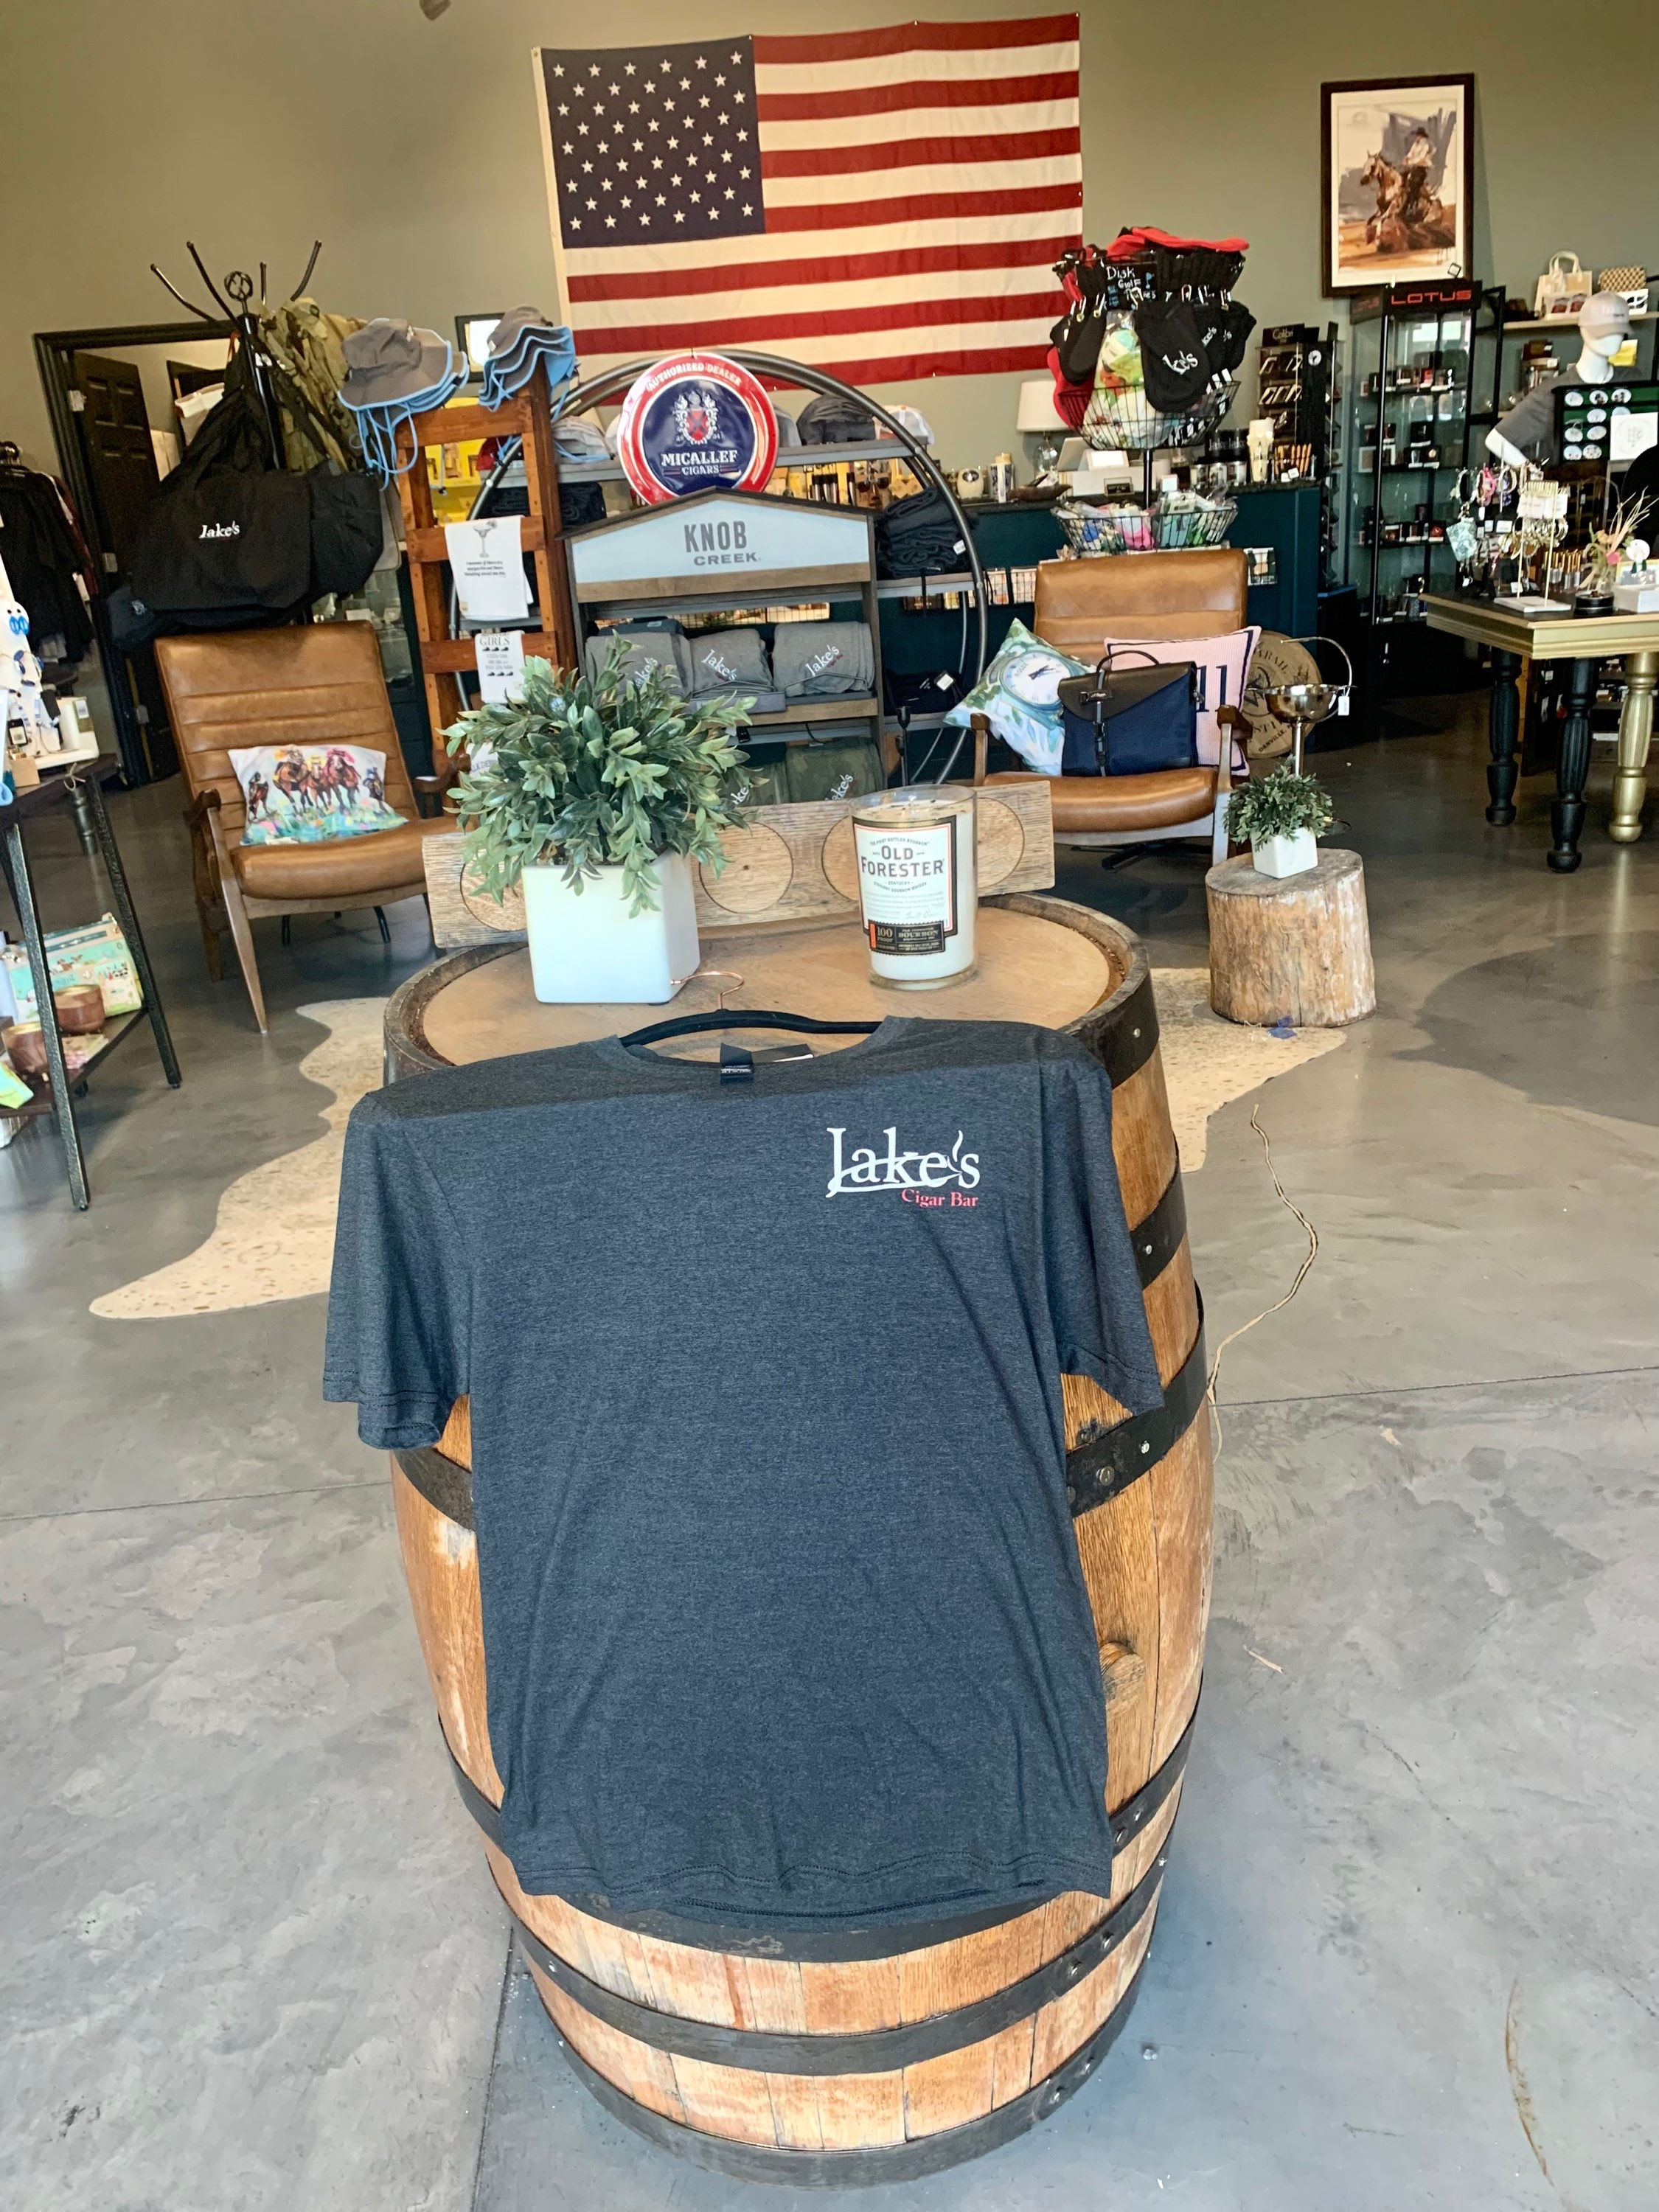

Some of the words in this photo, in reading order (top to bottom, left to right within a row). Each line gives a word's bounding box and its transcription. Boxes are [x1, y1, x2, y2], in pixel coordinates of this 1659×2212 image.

[1391, 290, 1472, 305] LOTUS
[647, 363, 704, 392] AUTHORIZED
[706, 364, 742, 387] DEALER
[661, 450, 737, 466] MICALLEF
[681, 465, 720, 476] CIGARS
[198, 520, 240, 538] Jake's
[684, 521, 747, 552] KNOB
[693, 552, 758, 566] CREEK
[479, 636, 510, 646] GIRLS
[701, 650, 737, 681] Jake's
[805, 644, 840, 676] Jake's
[634, 657, 658, 689] ake's
[881, 845, 914, 860] OLD
[861, 855, 944, 877] FORESTER
[877, 926, 893, 938] 100
[825, 1127, 980, 1198] Jake's
[901, 1189, 945, 1208] Cigar
[950, 1192, 978, 1207] Bar
